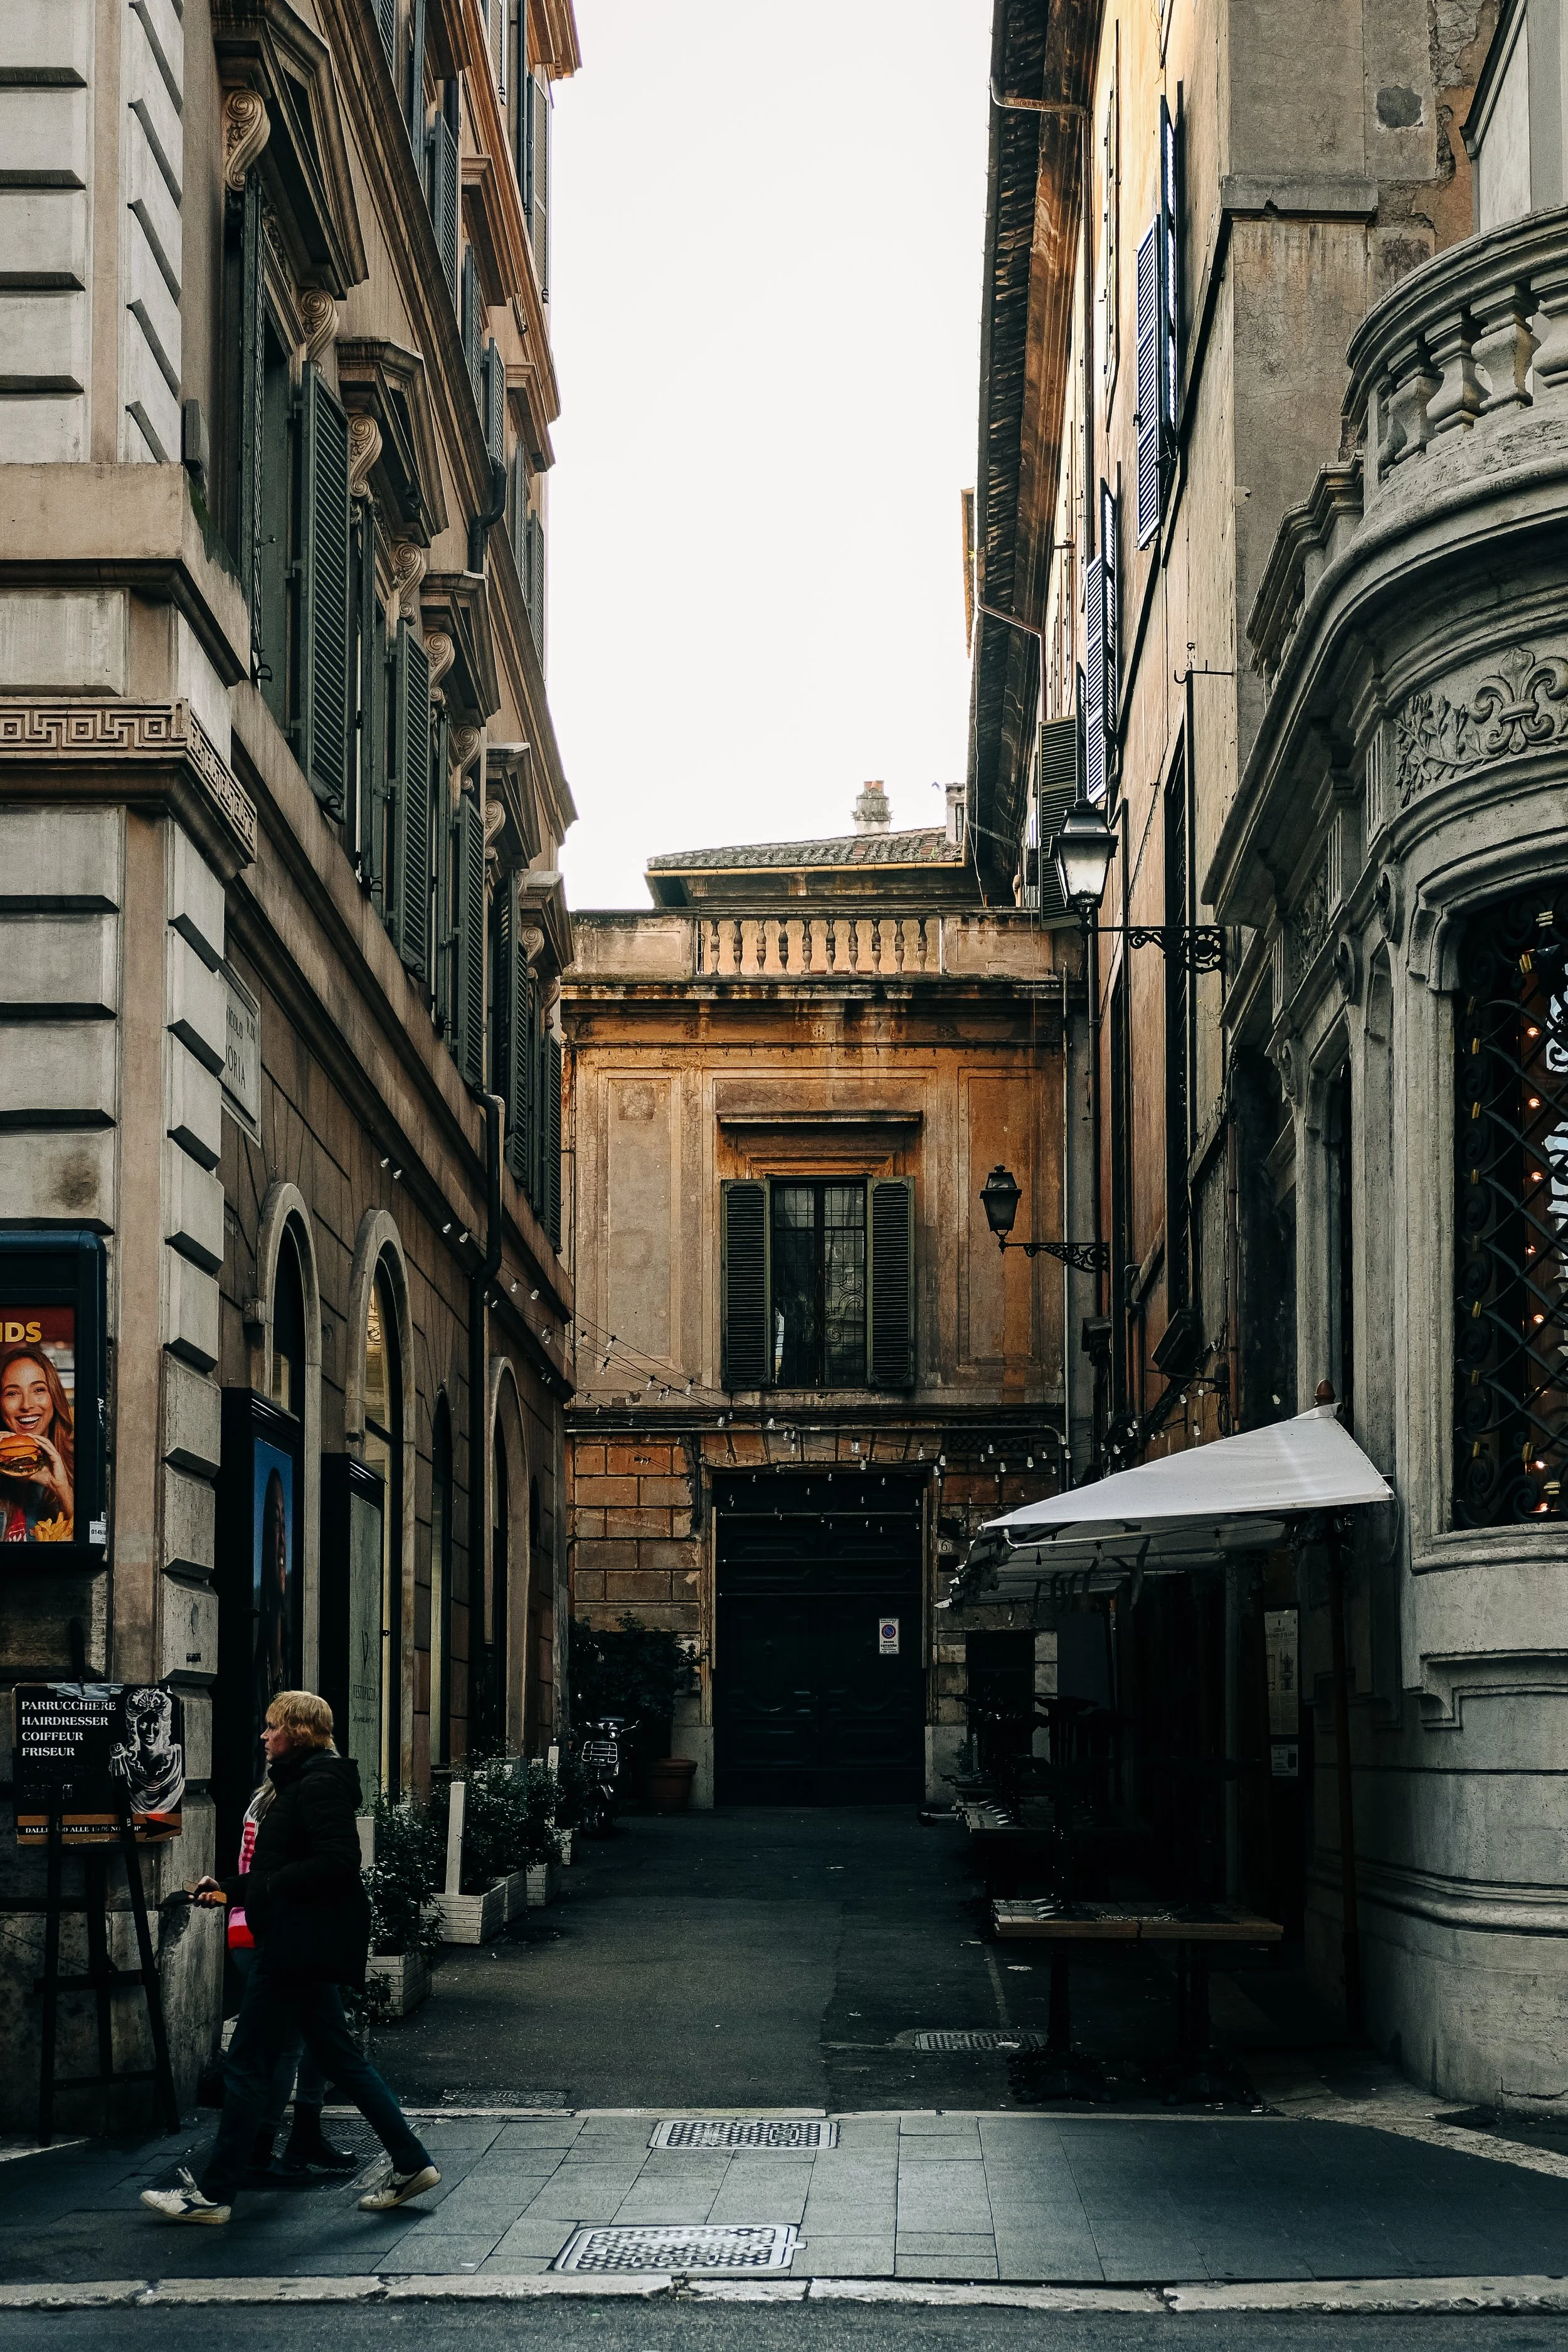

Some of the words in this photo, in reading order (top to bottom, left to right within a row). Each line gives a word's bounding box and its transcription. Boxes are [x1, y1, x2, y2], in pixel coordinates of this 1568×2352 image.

[0, 1322, 42, 1343] DS
[352, 1685, 376, 1702] VESTOPAZZO
[21, 1701, 116, 1711] PARRUCCHIERE
[21, 1716, 109, 1725] HAIRDRESSER
[21, 1732, 83, 1741] COIFFEUR
[21, 1747, 75, 1756] FRISEUR
